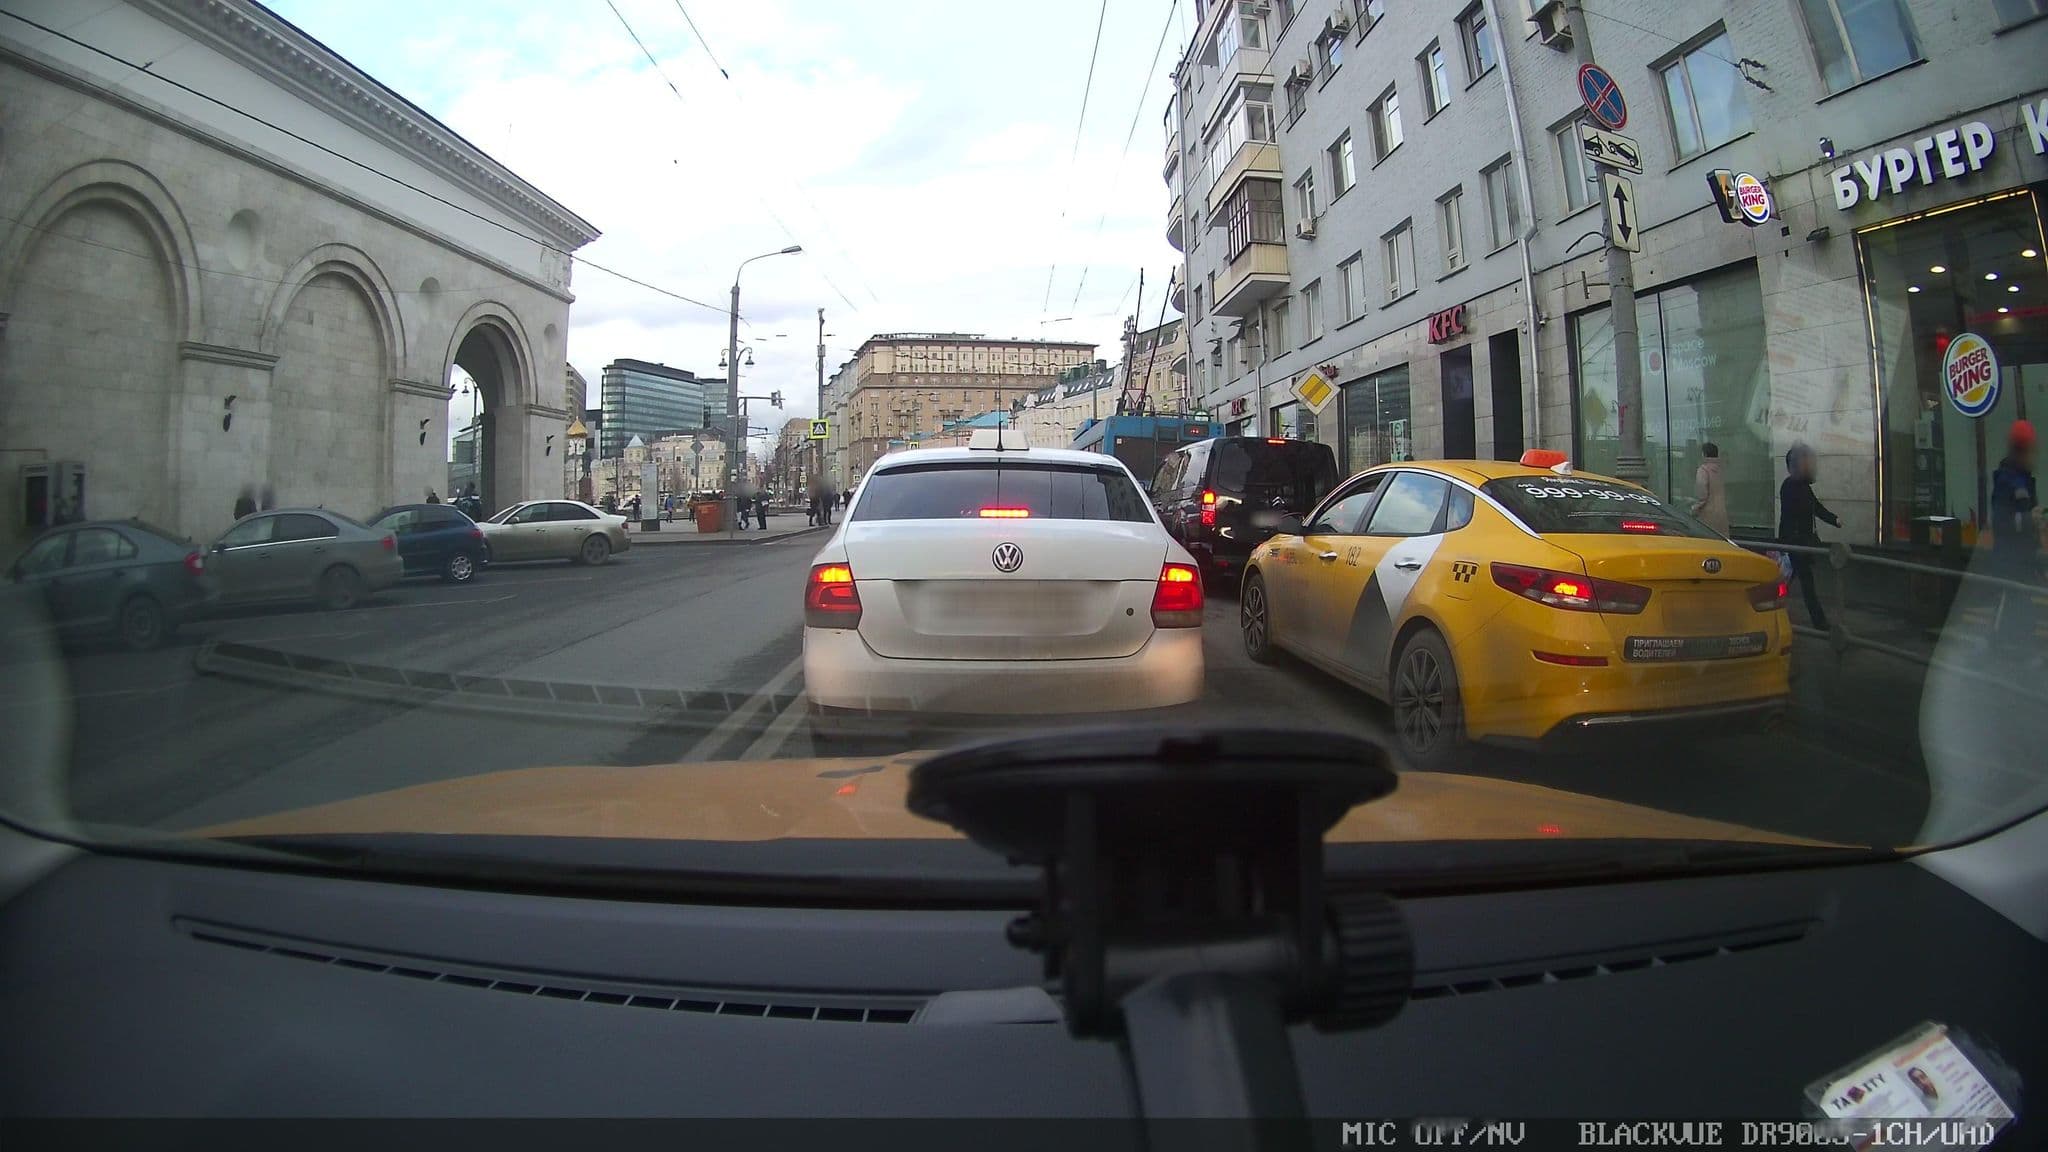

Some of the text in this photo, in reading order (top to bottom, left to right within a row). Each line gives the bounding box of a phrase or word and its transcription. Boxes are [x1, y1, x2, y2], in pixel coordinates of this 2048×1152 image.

[1831, 121, 1994, 210] БУРГЕР
[1739, 185, 1763, 196] BURGER
[1741, 194, 1766, 208] KING
[1428, 304, 1465, 343] KFC
[1949, 347, 1988, 380] BURGER
[1952, 361, 1992, 399] KING
[1525, 486, 1662, 506] 999-99-99
[1345, 545, 1362, 567] 182
[1633, 638, 1684, 649] ПРИГЛАШАЕМ
